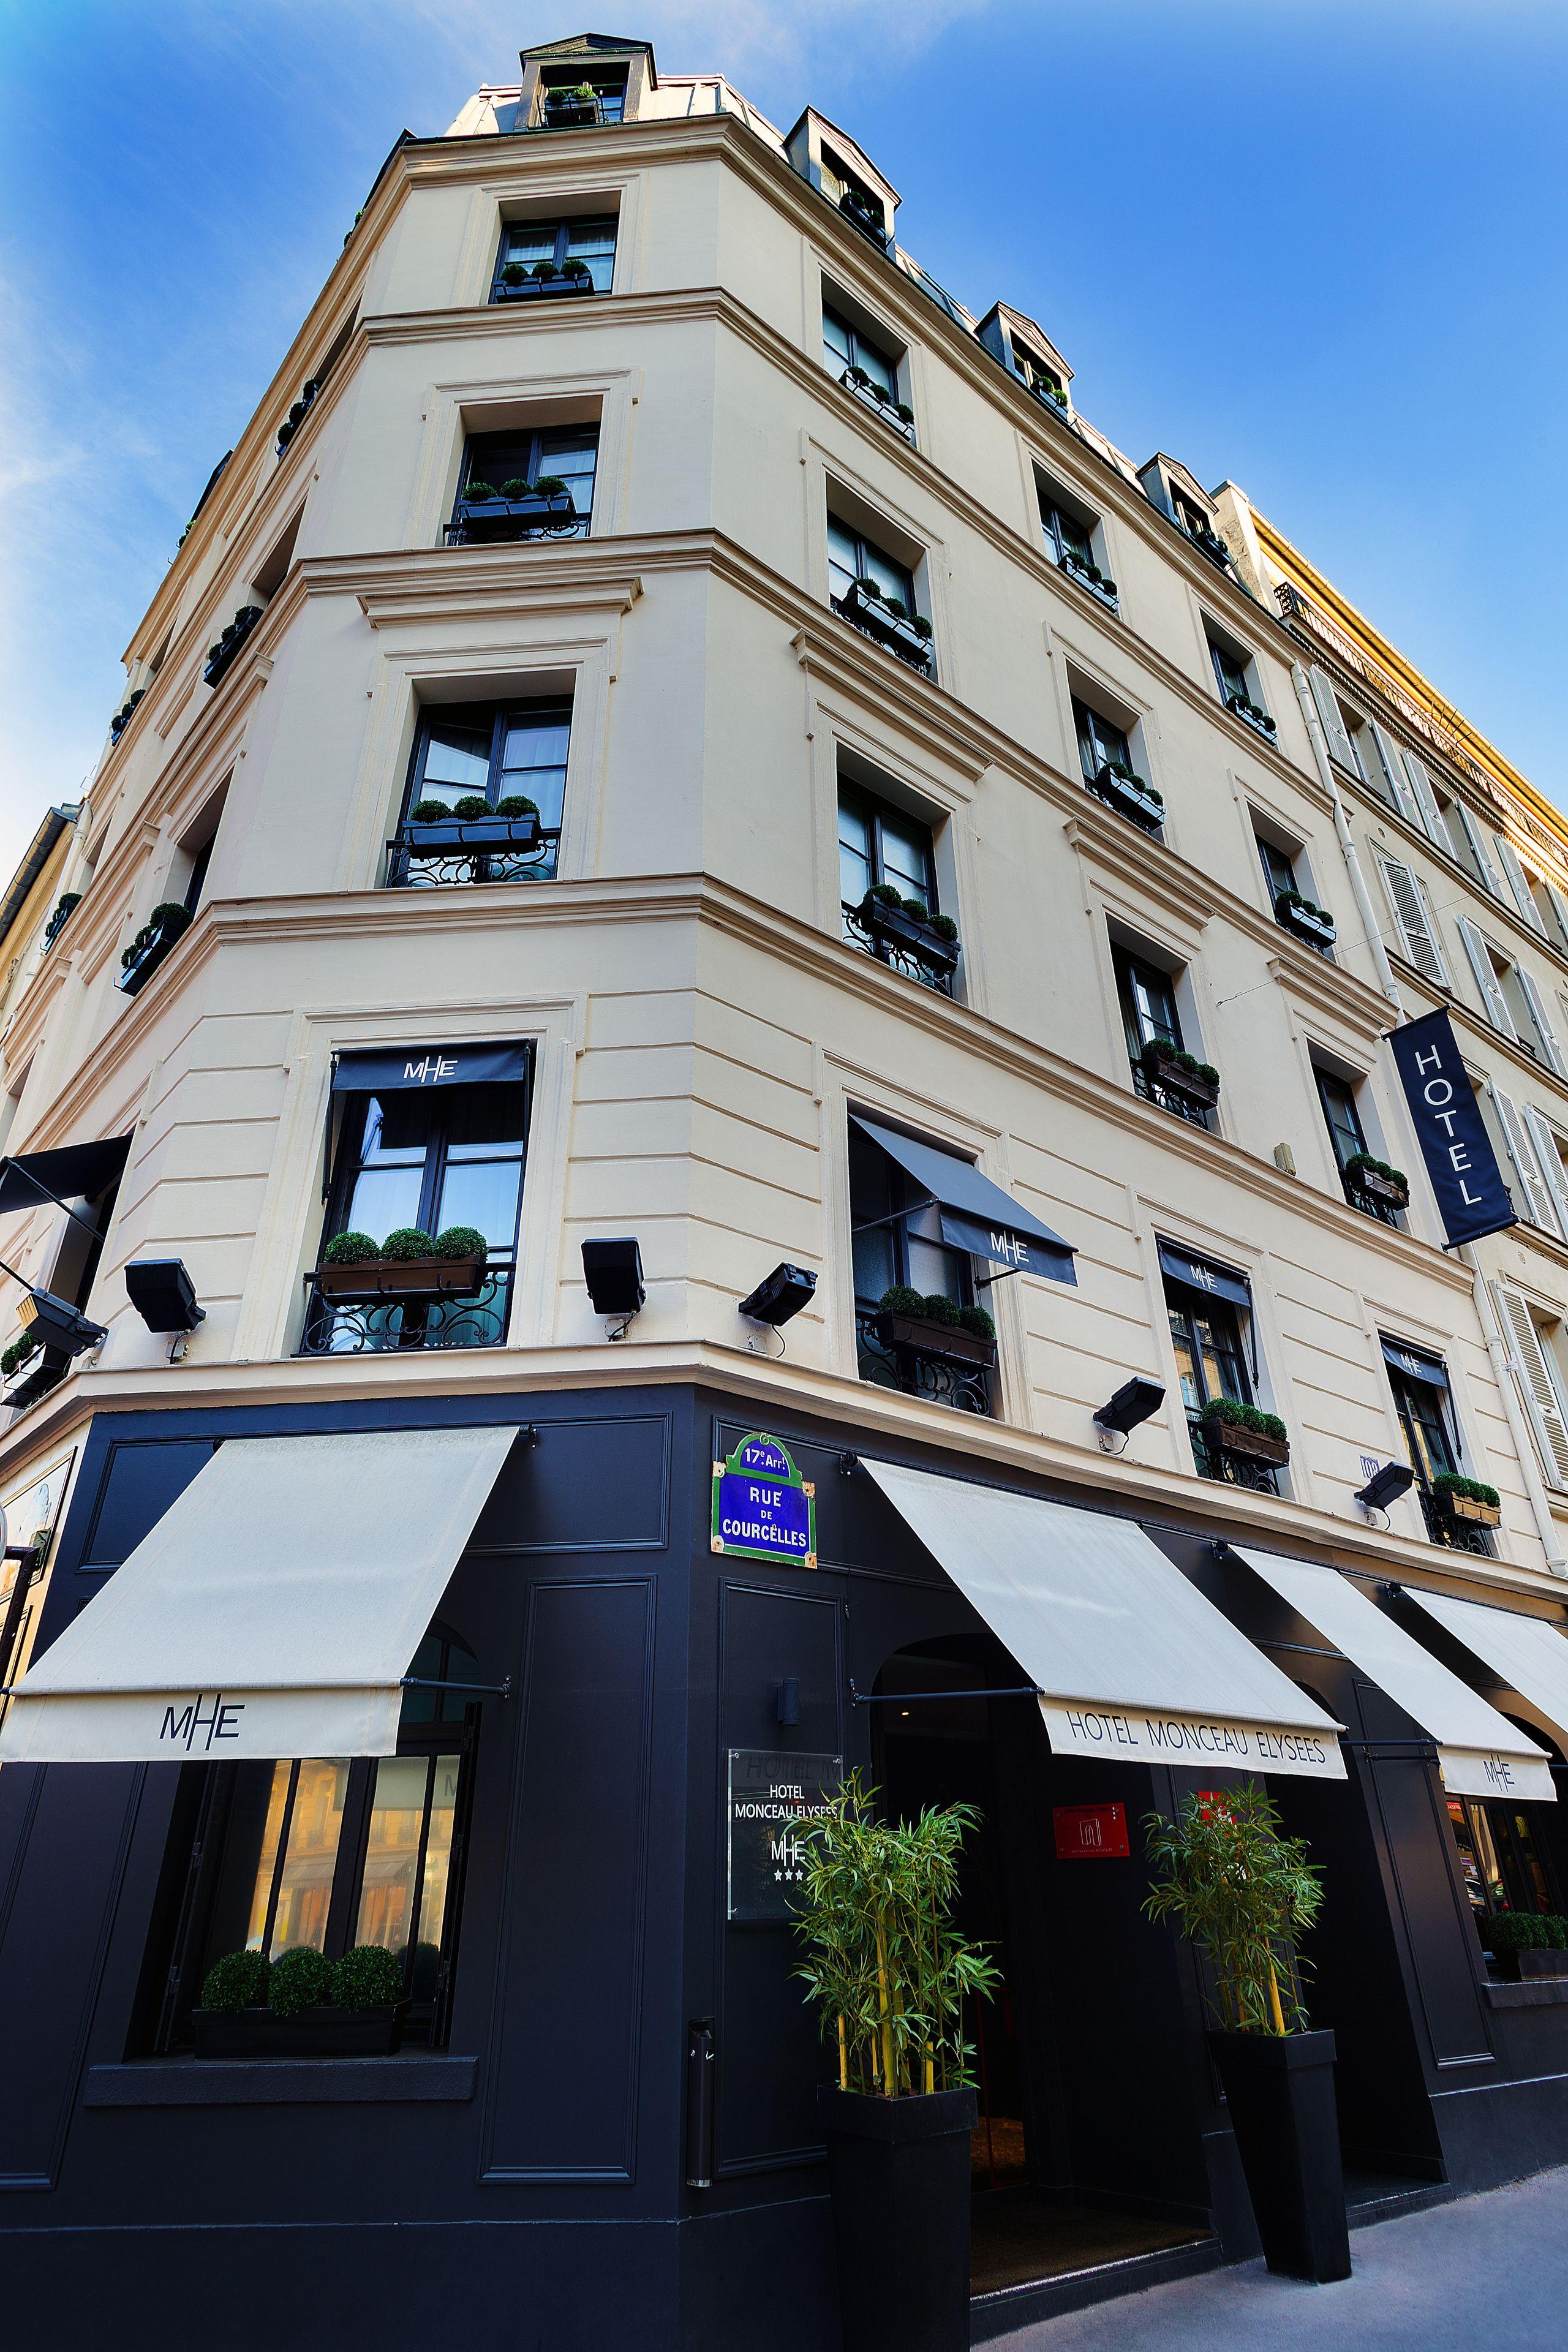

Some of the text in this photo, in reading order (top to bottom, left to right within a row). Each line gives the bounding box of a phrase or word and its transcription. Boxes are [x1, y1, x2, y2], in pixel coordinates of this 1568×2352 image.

[403, 1055, 458, 1083] MHE
[1415, 1044, 1482, 1205] HOTEL
[990, 1231, 1029, 1265] MHE
[1190, 1264, 1218, 1289] MHE
[1400, 1352, 1422, 1374] MHE
[750, 1487, 782, 1507] RUE
[761, 1510, 772, 1520] DE
[723, 1519, 806, 1547] COURCELLES
[159, 1693, 245, 1751] MHE
[1066, 1710, 1325, 1763] HOTEL MONCEAU ELYSEES
[1483, 1754, 1515, 1792] MHE
[770, 1784, 805, 1799] HOTEL
[735, 1803, 793, 1819] MONCEAU
[771, 1834, 805, 1866] MHE
